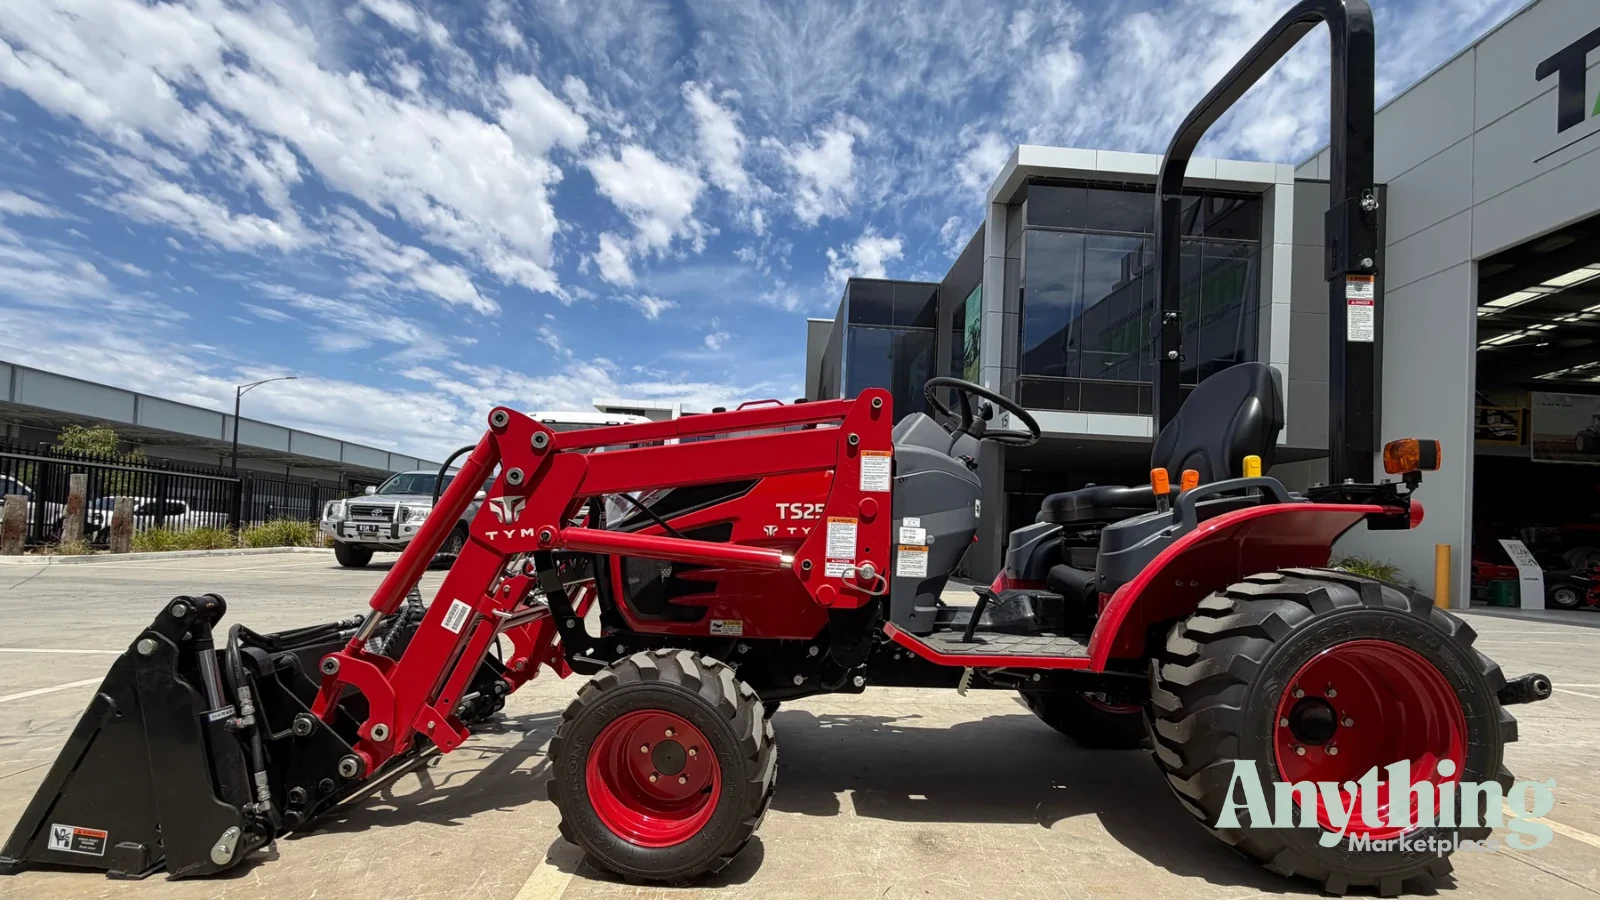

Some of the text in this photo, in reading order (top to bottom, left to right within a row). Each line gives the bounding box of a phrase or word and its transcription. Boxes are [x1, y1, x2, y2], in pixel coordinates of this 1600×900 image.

[1001, 414, 1009, 429] 15
[485, 527, 535, 541] TYM
[786, 526, 812, 535] TY
